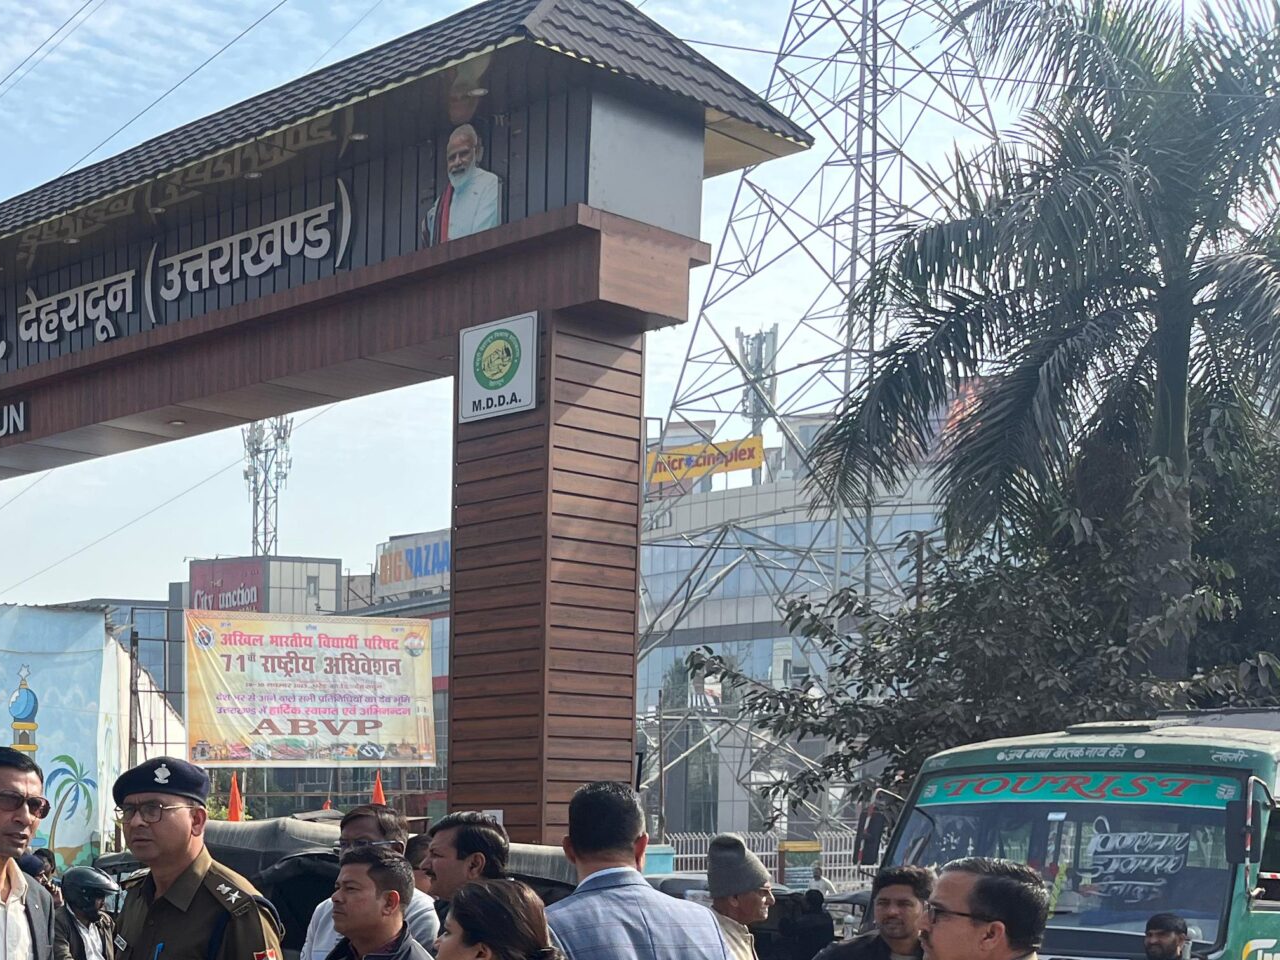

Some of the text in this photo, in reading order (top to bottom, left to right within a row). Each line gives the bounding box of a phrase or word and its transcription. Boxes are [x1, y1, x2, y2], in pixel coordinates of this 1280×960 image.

[18, 270, 136, 342] देहरादून
[145, 178, 352, 323] (उत्तराखण्ड)
[472, 392, 522, 412] M.D.D.A.
[404, 541, 450, 581] BAZAA
[220, 630, 265, 647] अखिल
[269, 632, 313, 648] भारतीय
[260, 651, 316, 677] राष्ट्रीय
[324, 652, 402, 676] अधिवेशन
[269, 704, 301, 715] हार्दिक
[249, 718, 383, 736] ABVP
[943, 774, 1214, 799] TOURIST
